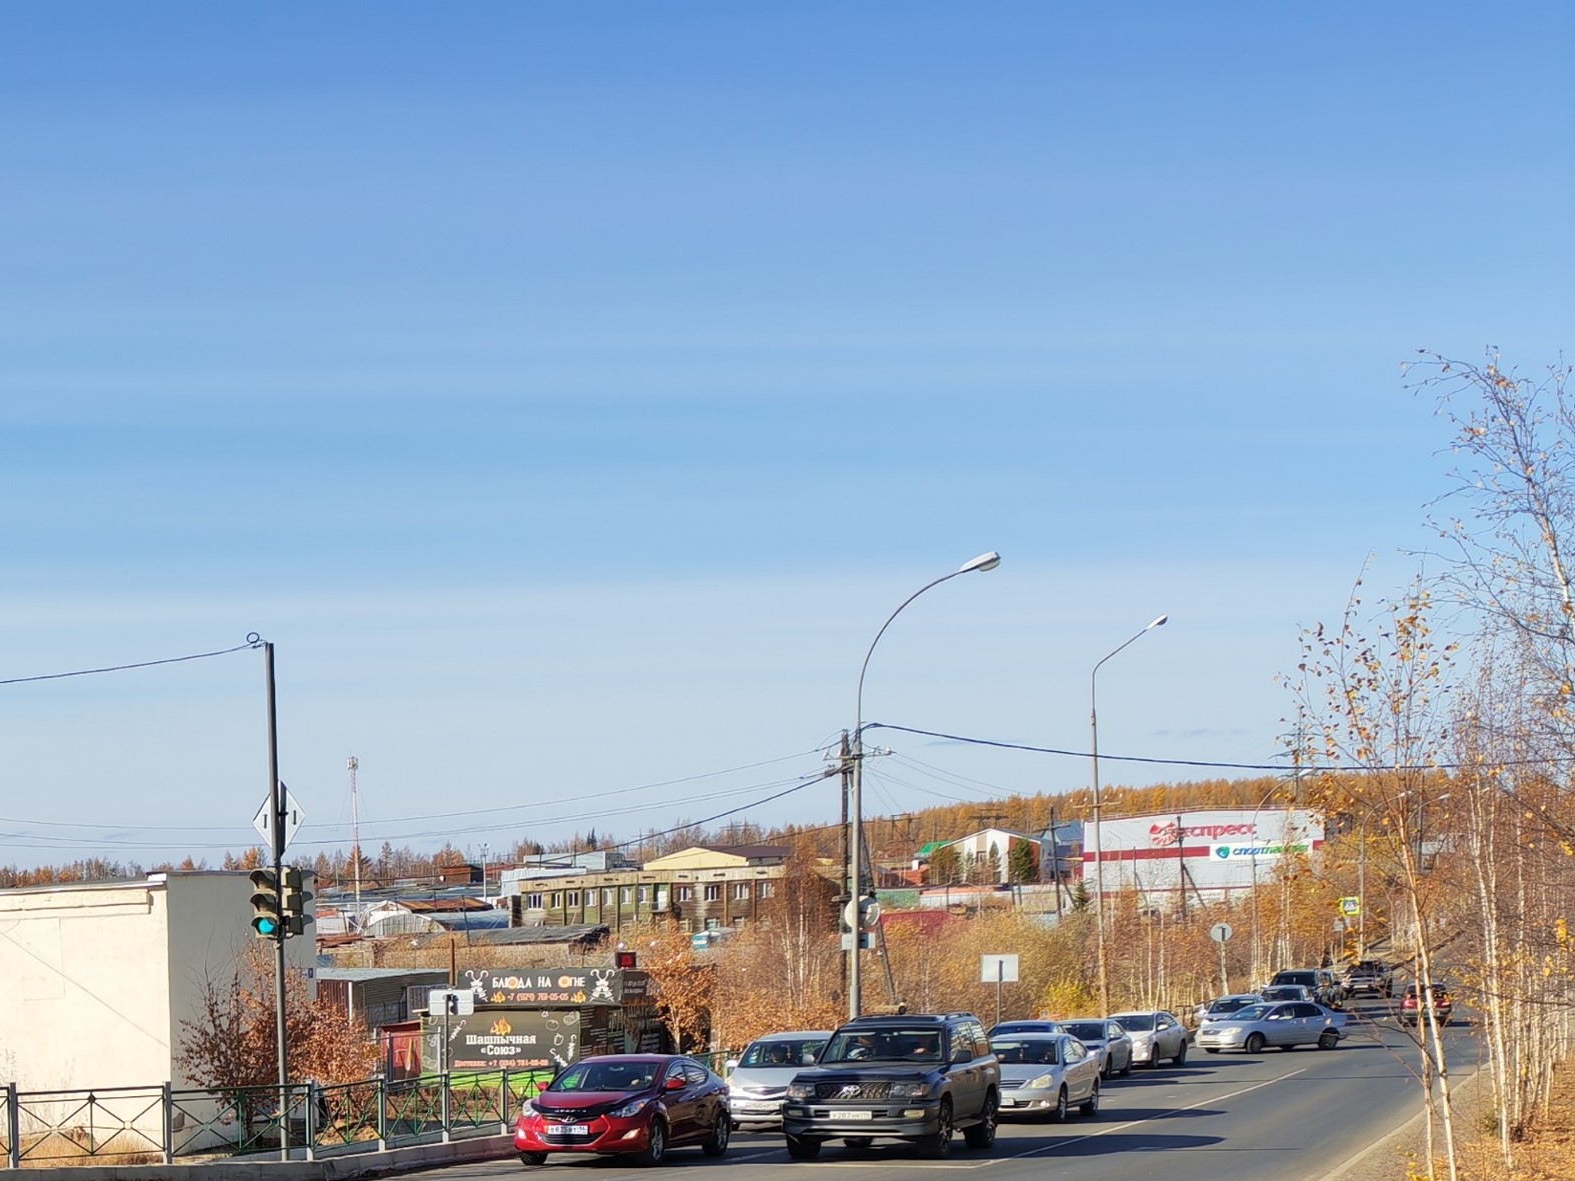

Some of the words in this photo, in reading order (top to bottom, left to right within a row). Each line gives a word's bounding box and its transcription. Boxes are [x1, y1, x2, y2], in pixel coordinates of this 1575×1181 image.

[492, 976, 532, 989] БЛЮДА
[538, 976, 552, 988] НА
[558, 976, 586, 988] ОГНЕ
[466, 1034, 537, 1045] Шашлычная
[481, 1045, 522, 1056] «Союз»
